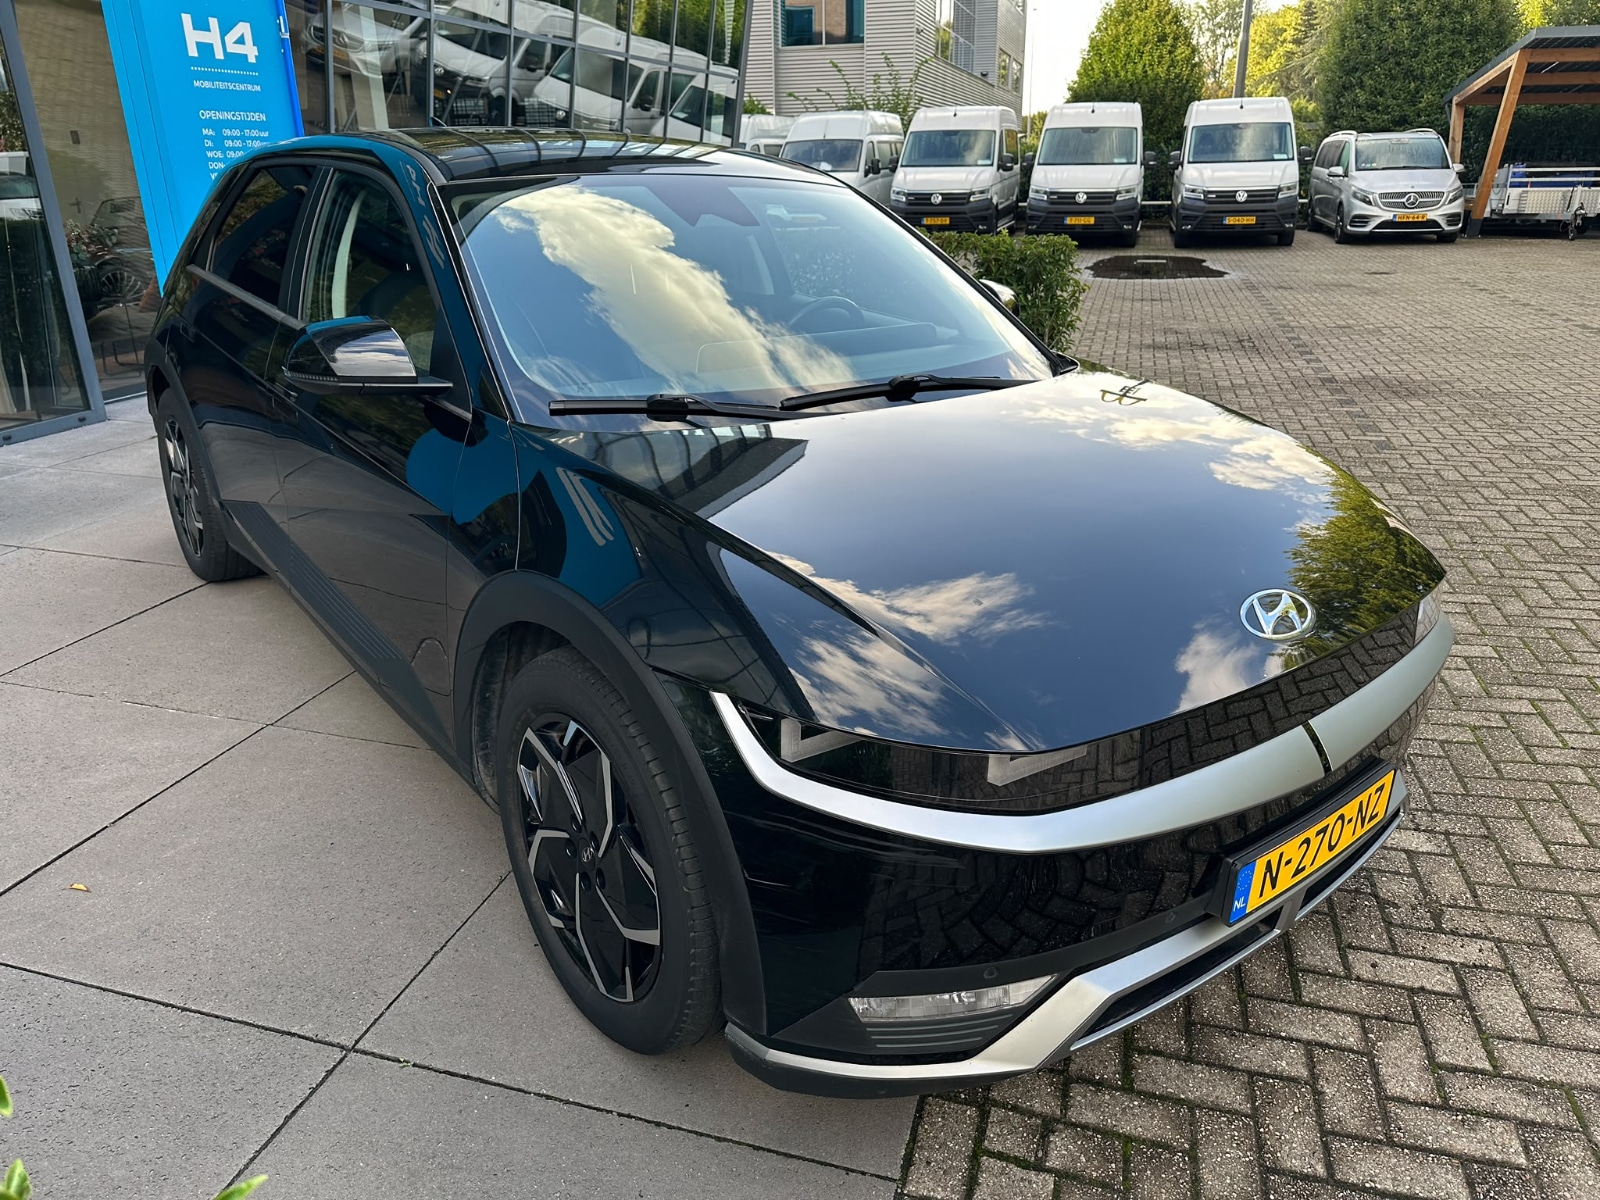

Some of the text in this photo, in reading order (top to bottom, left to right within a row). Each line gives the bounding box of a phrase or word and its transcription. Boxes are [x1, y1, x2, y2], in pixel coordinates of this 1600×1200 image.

[181, 12, 259, 64] H4
[193, 80, 261, 92] MOBILITEITSCENTRUM
[199, 109, 266, 122] OPENINGSTIJDEN
[202, 128, 216, 136] MA:
[1259, 782, 1386, 899] N-270-NZ
[1233, 896, 1247, 912] NL
